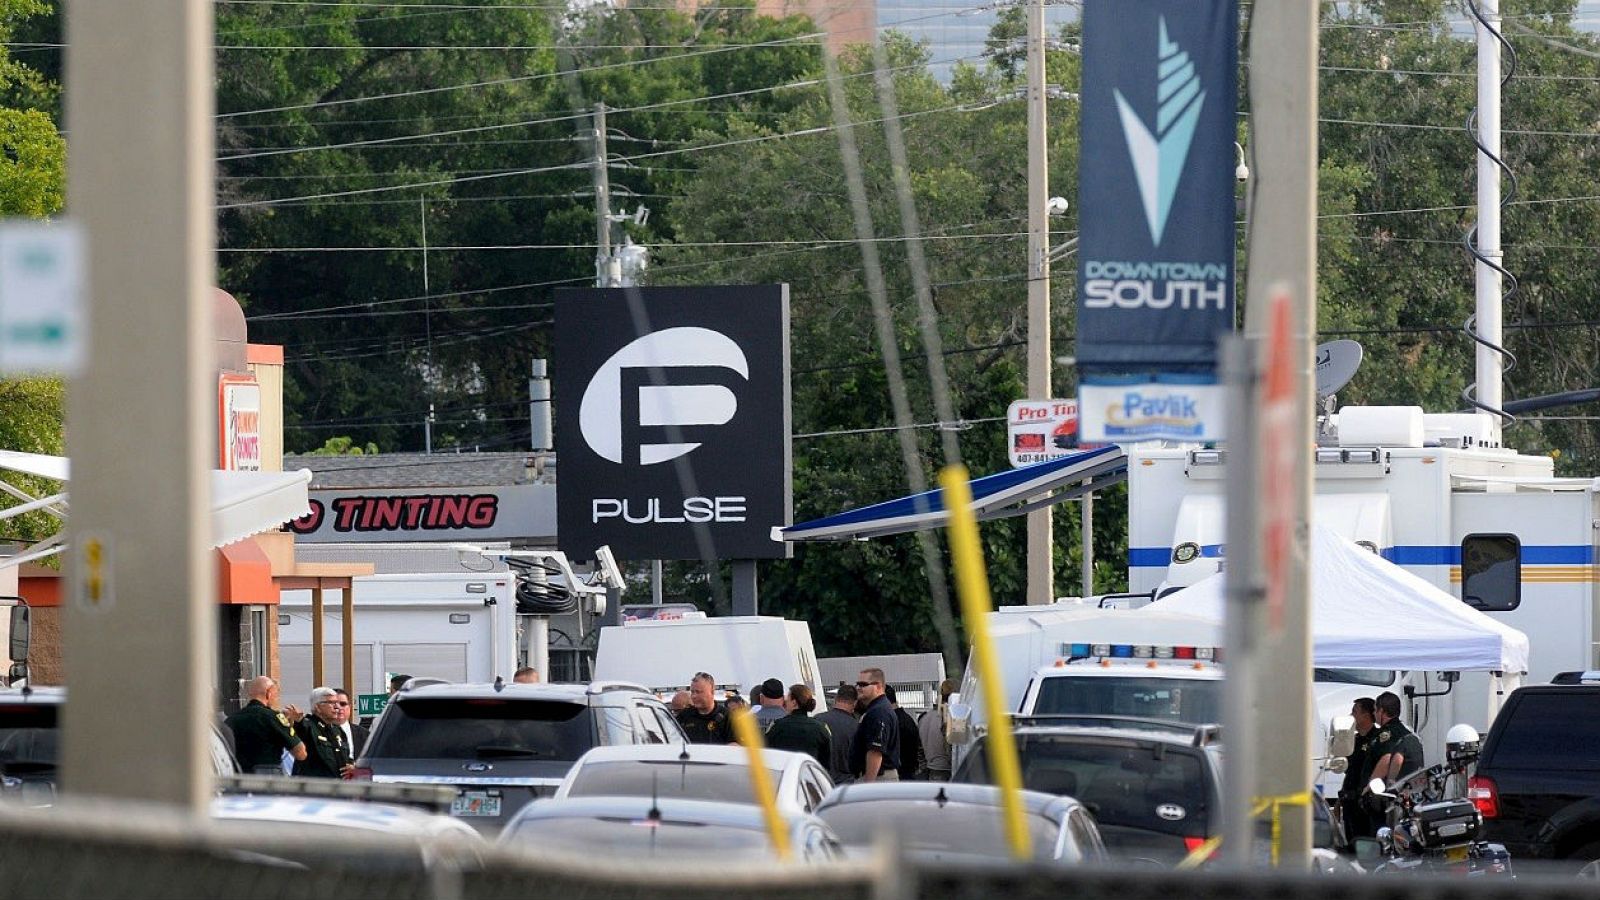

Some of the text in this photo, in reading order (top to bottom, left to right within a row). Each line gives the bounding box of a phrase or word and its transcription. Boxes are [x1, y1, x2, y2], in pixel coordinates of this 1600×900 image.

[1085, 261, 1226, 280] DOWNTOWN
[1084, 279, 1226, 310] SOUTH
[1018, 403, 1080, 420] Pro Tin
[1123, 392, 1197, 418] Pavlik
[335, 495, 497, 531] TINTING
[592, 496, 747, 524] PULSE
[360, 698, 370, 712] W
